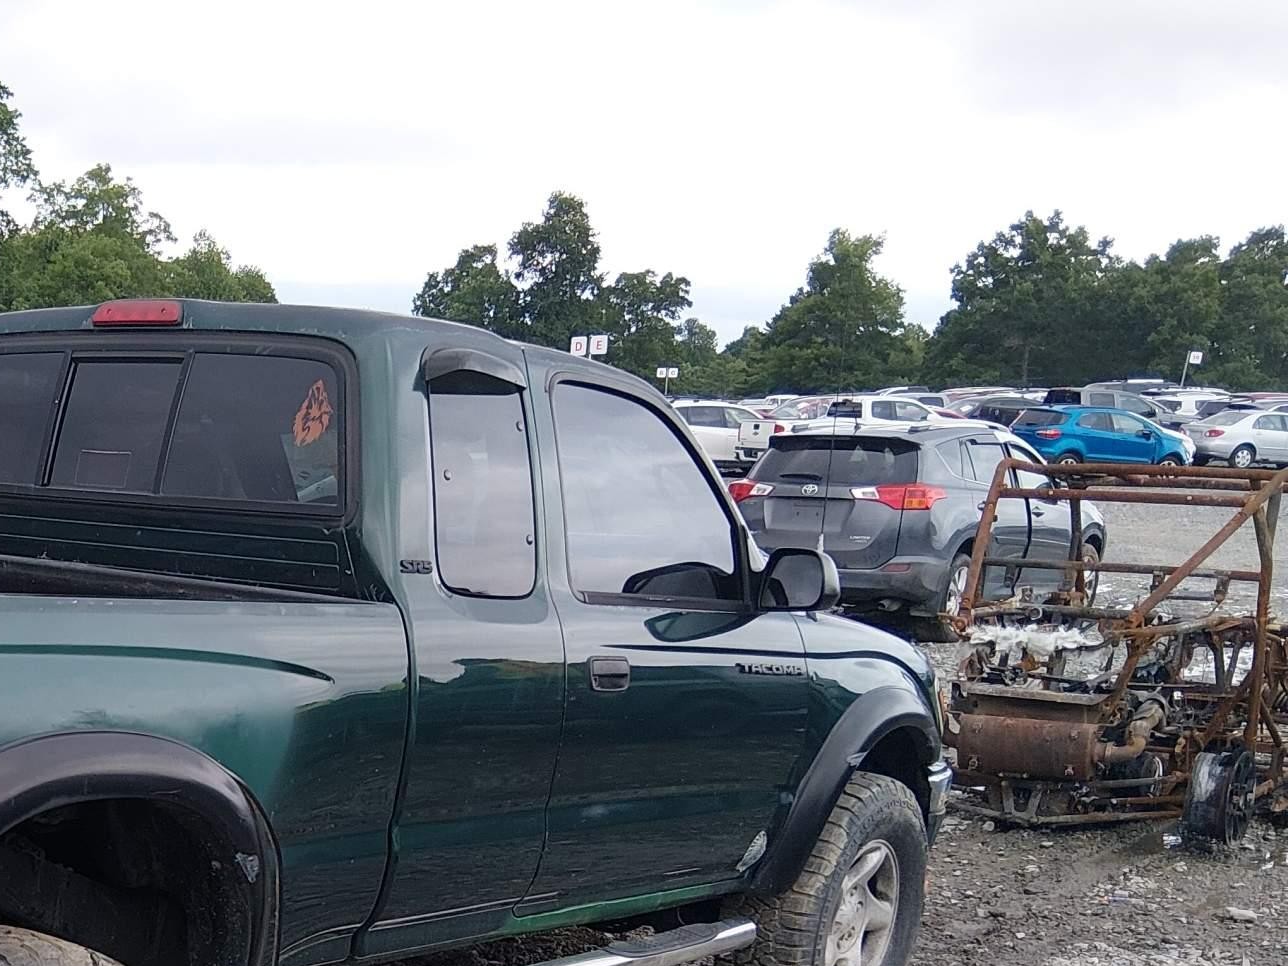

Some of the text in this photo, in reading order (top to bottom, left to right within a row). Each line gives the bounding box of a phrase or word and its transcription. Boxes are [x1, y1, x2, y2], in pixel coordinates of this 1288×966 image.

[575, 341, 583, 351] D
[596, 340, 603, 350] E
[400, 560, 432, 574] SR5
[741, 663, 804, 675] TACOMA
